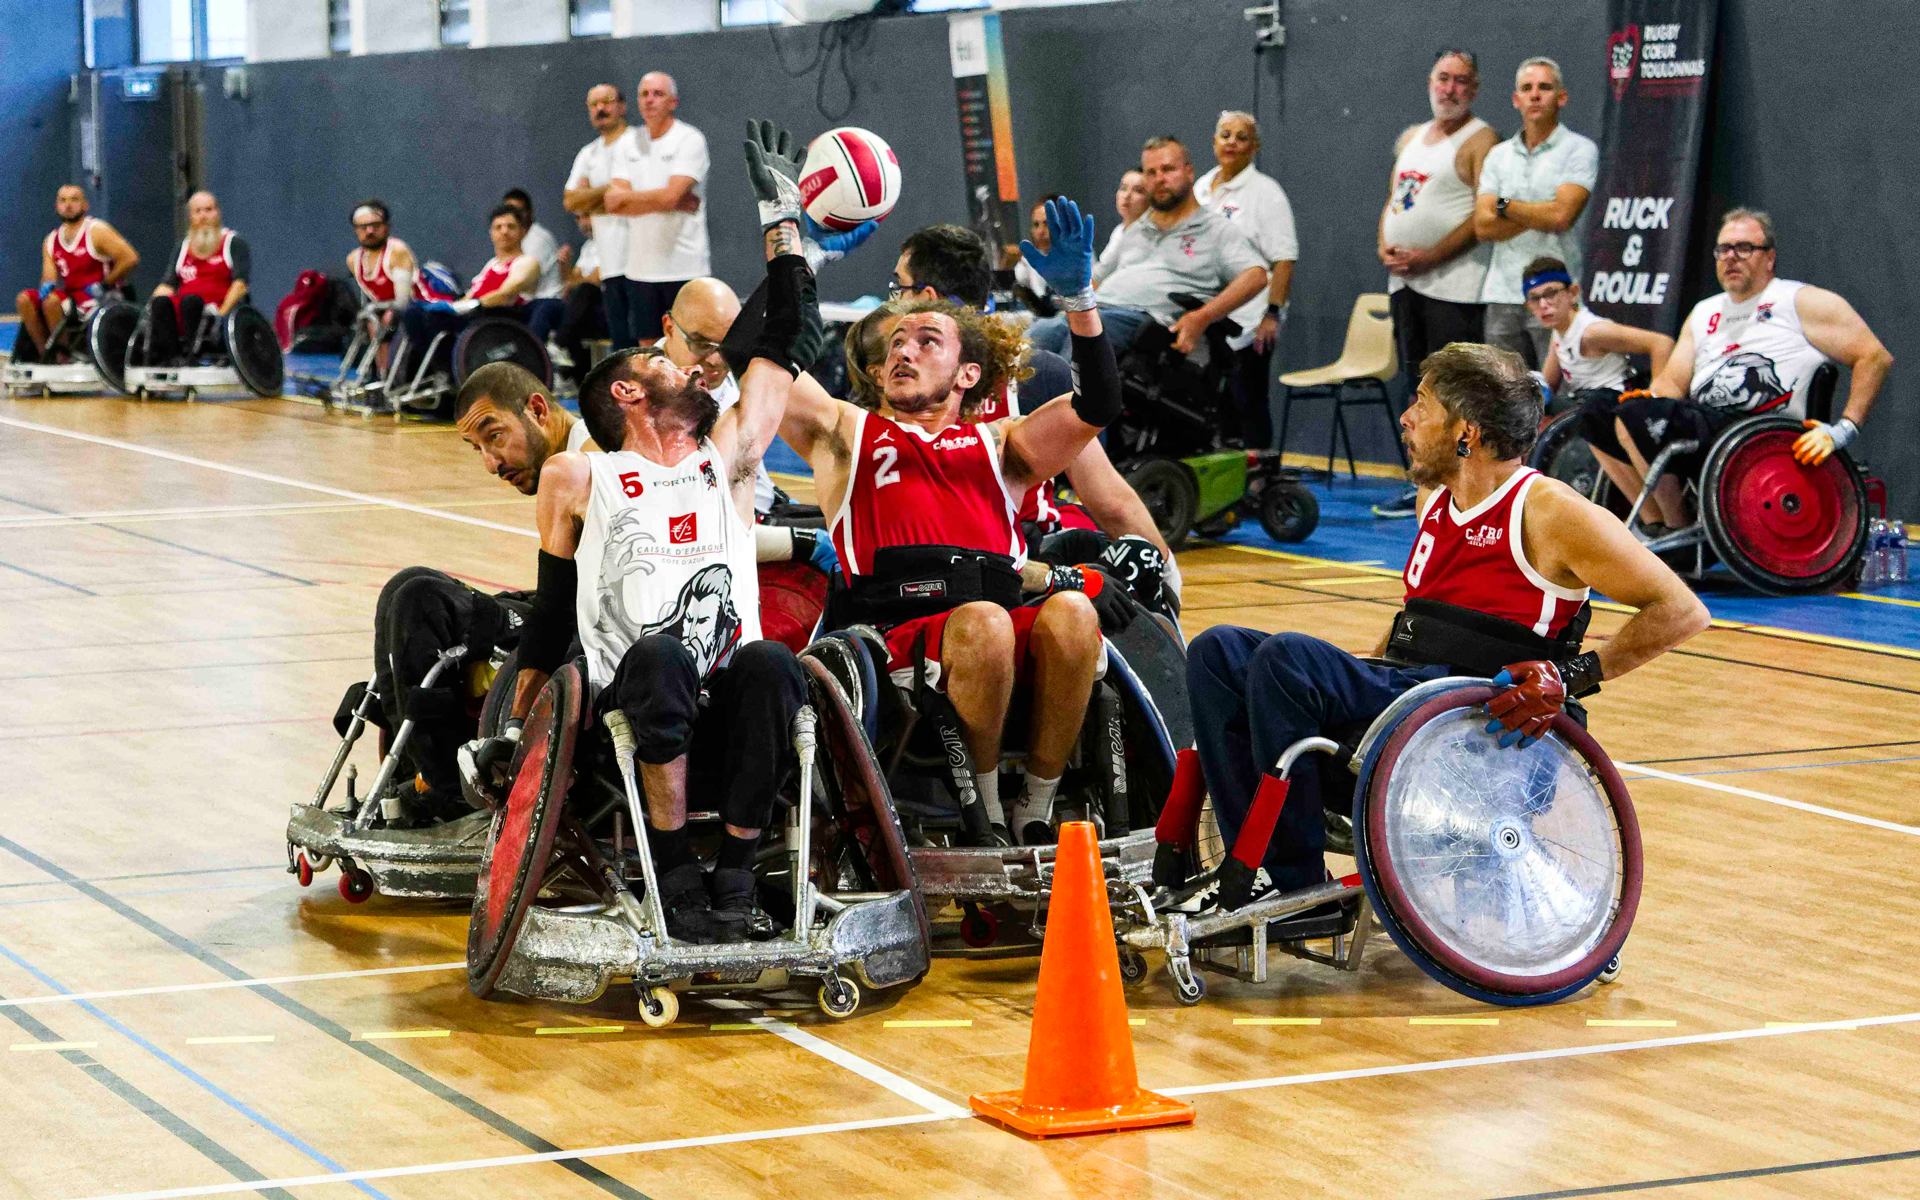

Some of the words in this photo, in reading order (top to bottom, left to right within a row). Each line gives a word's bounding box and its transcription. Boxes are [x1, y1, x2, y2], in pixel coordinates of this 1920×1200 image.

[1644, 24, 1681, 41] RUGBY
[1603, 196, 1675, 230] RUCK
[1622, 234, 1643, 266] &
[1589, 270, 1671, 304] ROULE
[1707, 312, 1721, 335] 9
[872, 446, 901, 489] 2
[619, 471, 644, 498] 5
[636, 546, 671, 555] CAISSE
[1407, 530, 1436, 589] 8
